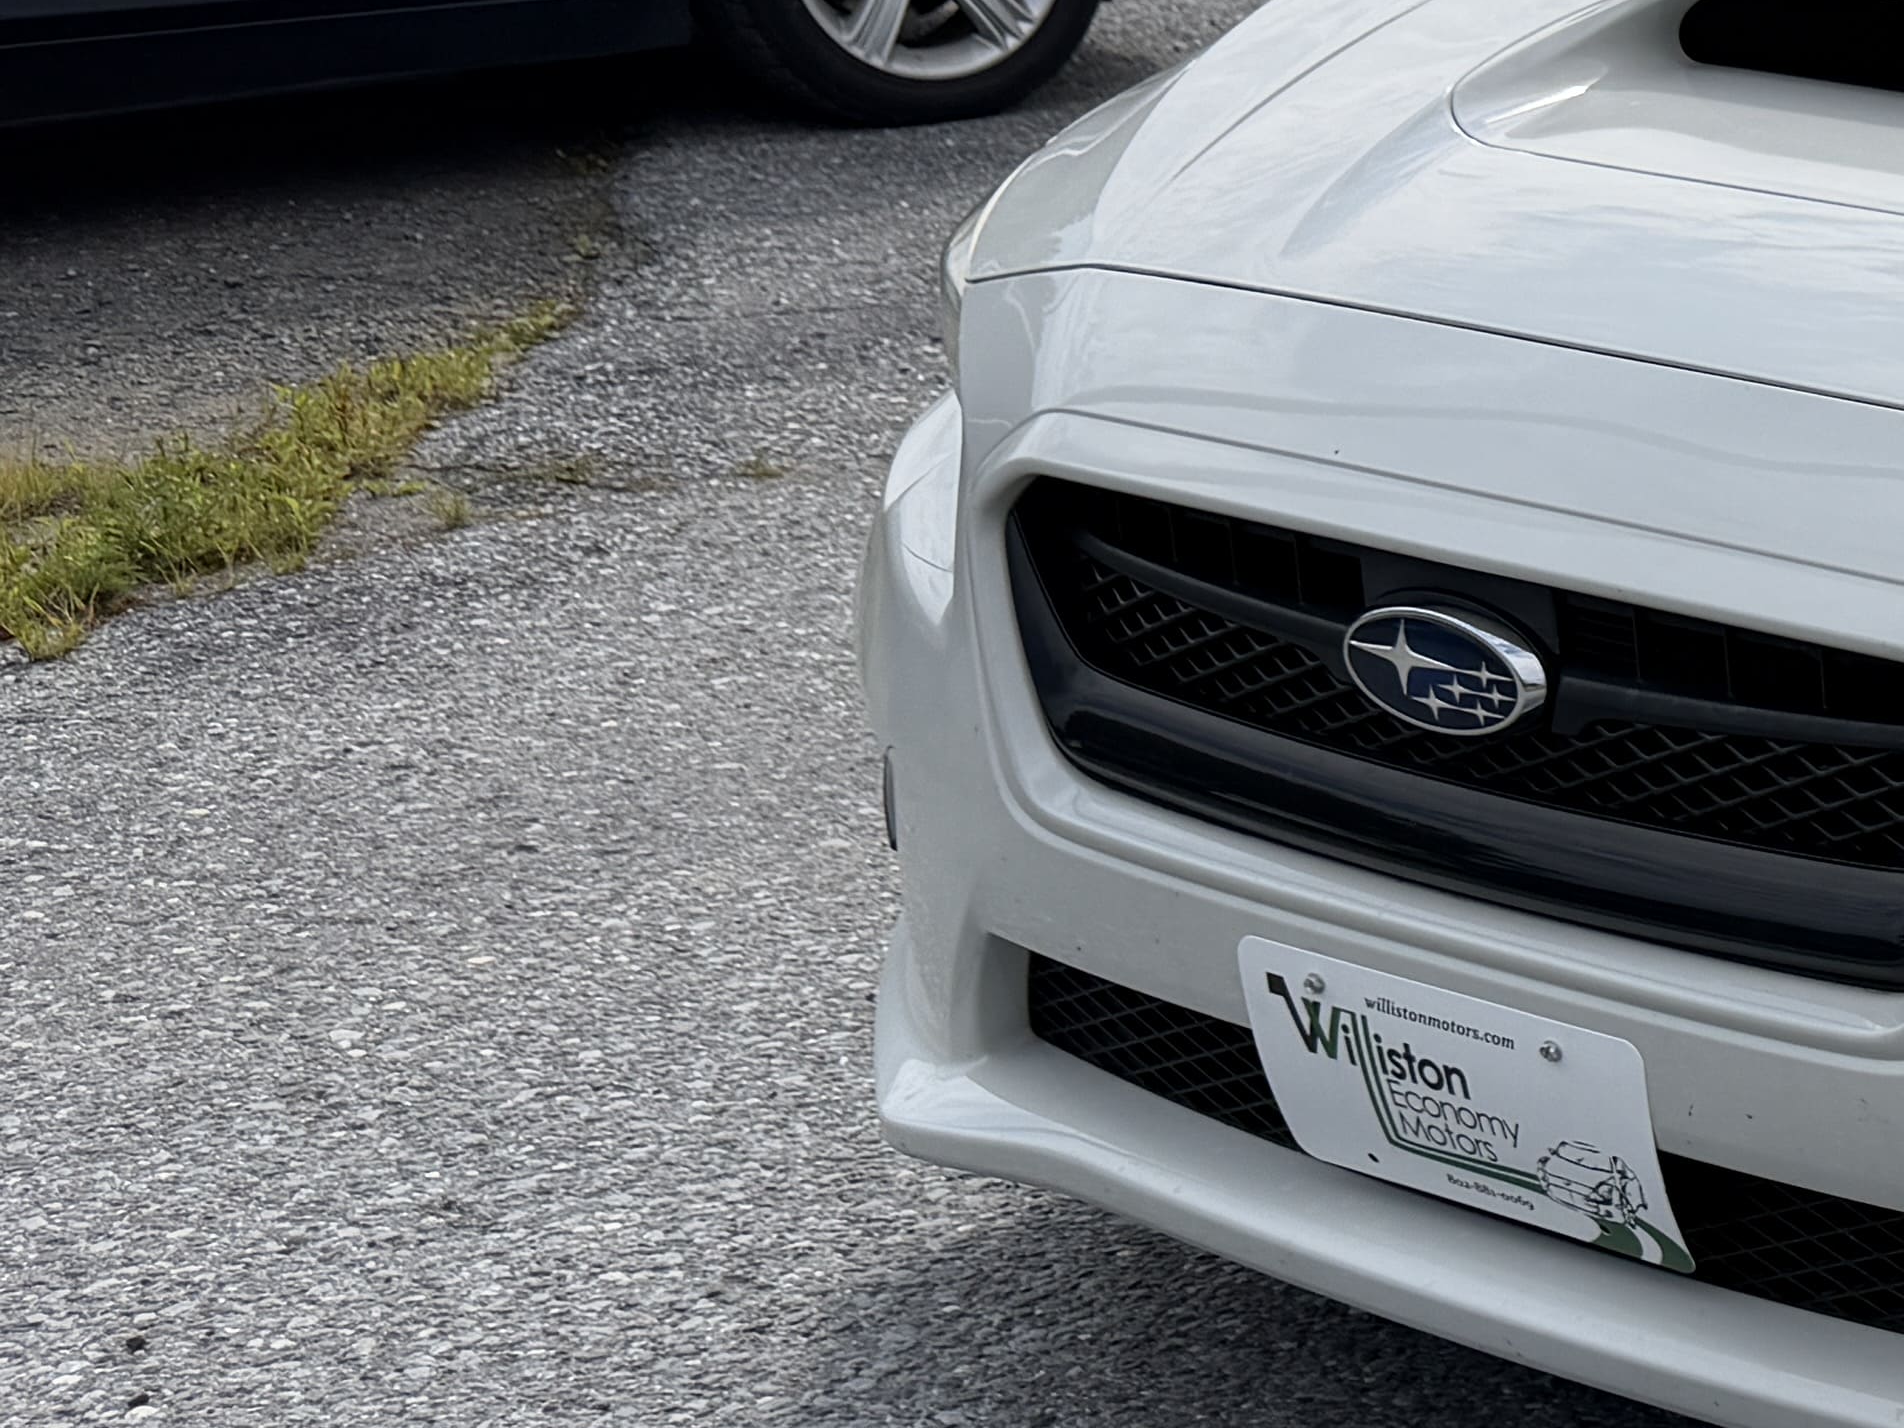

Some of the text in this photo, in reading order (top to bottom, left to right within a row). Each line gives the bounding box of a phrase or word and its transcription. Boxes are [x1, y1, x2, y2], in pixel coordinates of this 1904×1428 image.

[1265, 971, 1471, 1100] Williston
[1364, 996, 1515, 1051] willistonmotors.com
[1386, 1068, 1519, 1149] Economy
[1399, 1110, 1498, 1163] Motors
